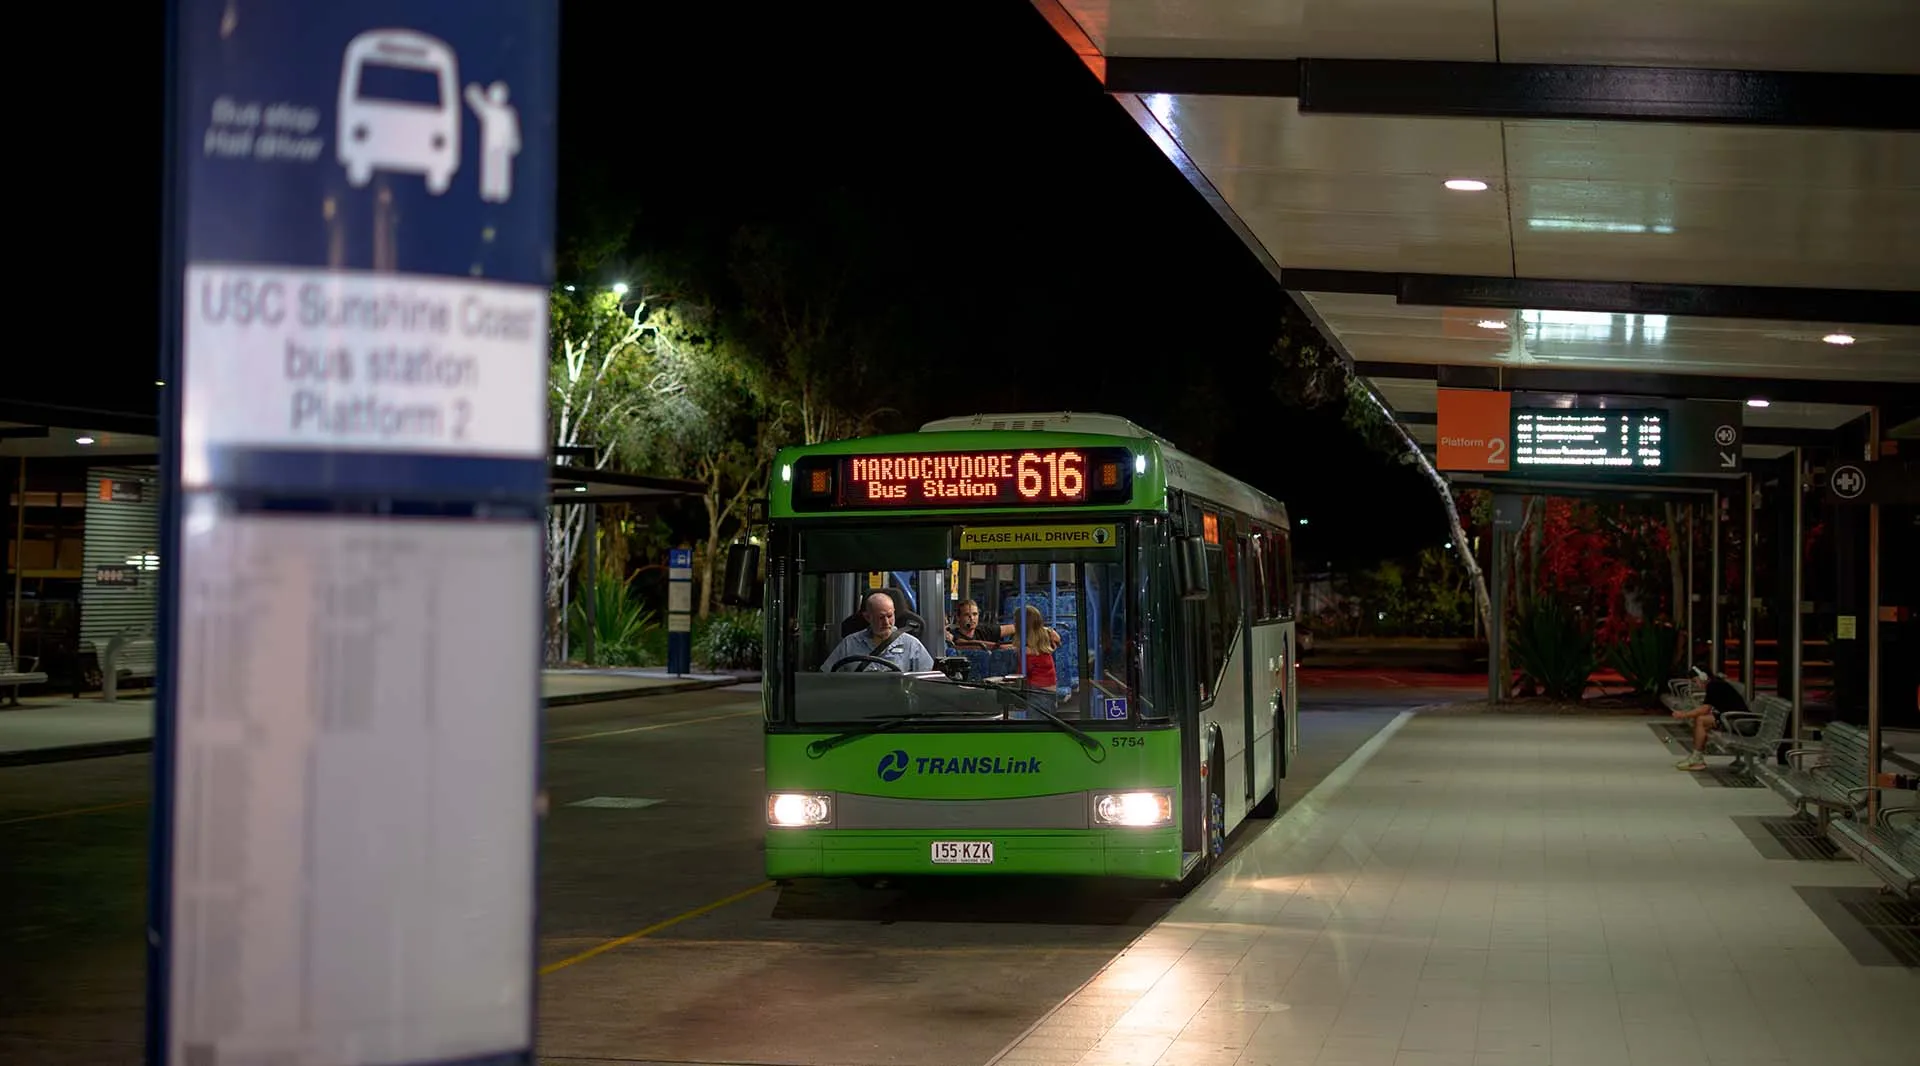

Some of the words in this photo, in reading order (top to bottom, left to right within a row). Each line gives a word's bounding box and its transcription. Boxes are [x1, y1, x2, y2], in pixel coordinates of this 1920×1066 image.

[201, 276, 285, 325] USC
[299, 280, 450, 333] Sunshine
[286, 340, 353, 381] bus
[367, 346, 479, 388] station
[291, 391, 445, 437] Platform
[452, 398, 474, 439] 2
[1441, 437, 1484, 447] Platform
[1487, 437, 1505, 464] 2
[853, 456, 1013, 481] MAROOCHYDORE
[1017, 452, 1083, 497] 616
[868, 481, 907, 498] Bus
[923, 479, 997, 497] Station
[966, 533, 1011, 543] PLEASE
[1015, 532, 1042, 542] HAIL
[1045, 531, 1090, 541] DRIVER
[1111, 737, 1145, 748] 5754
[916, 756, 1041, 775] TRANSLink
